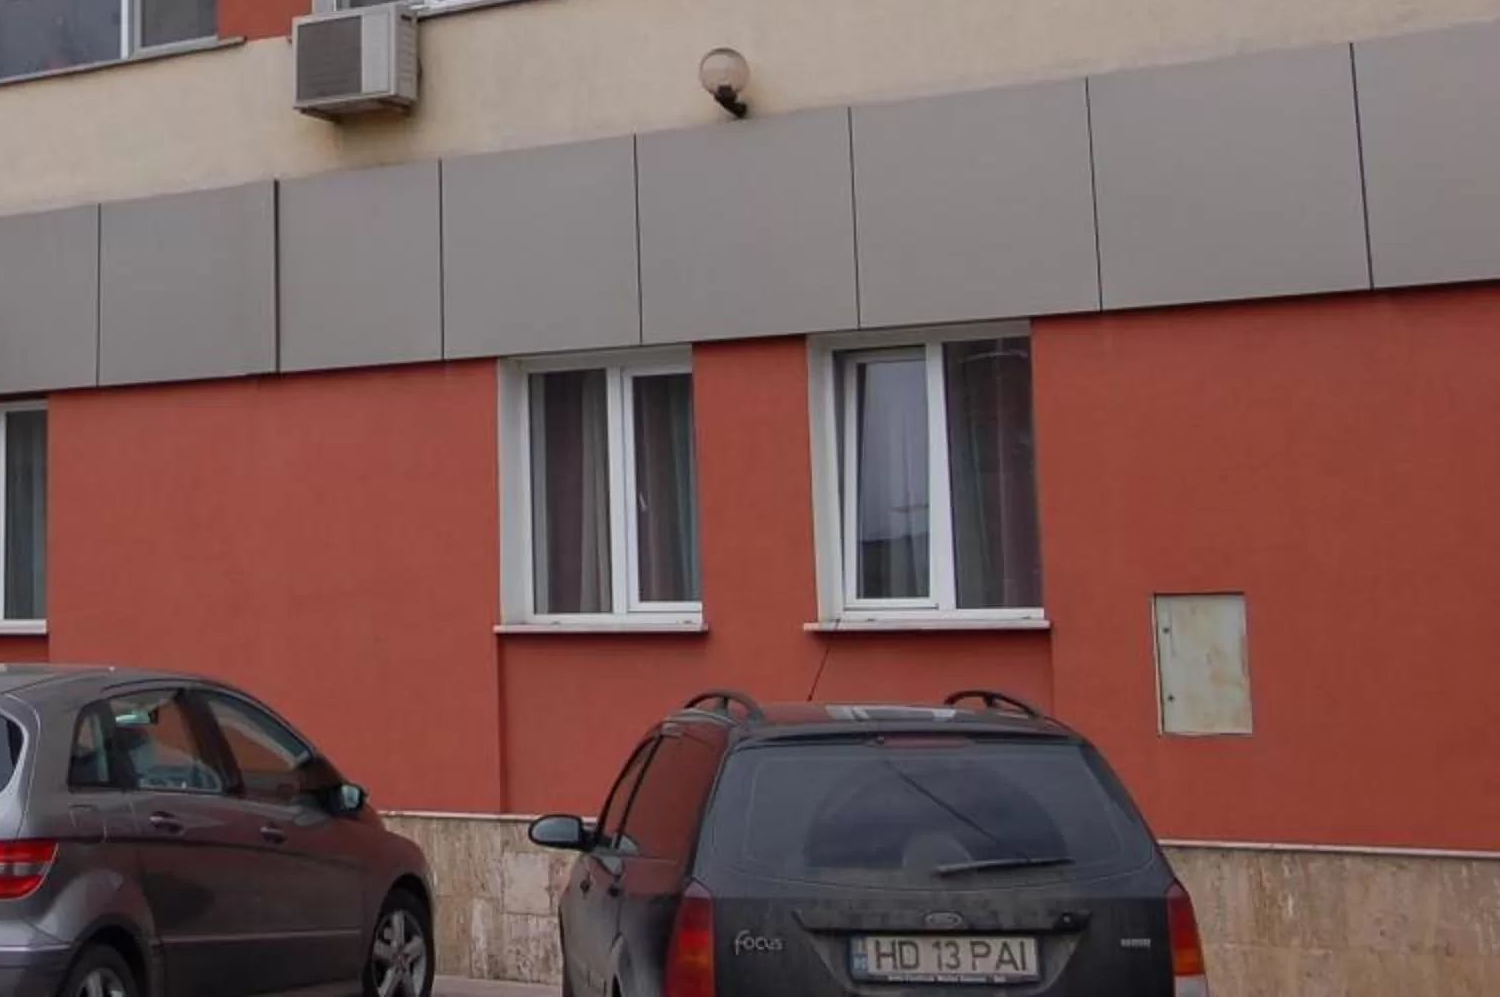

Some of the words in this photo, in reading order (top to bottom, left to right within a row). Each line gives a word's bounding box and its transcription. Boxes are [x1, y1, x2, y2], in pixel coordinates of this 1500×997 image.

[874, 939, 920, 971] HD
[931, 940, 960, 971] 13
[970, 939, 1027, 972] PAI
